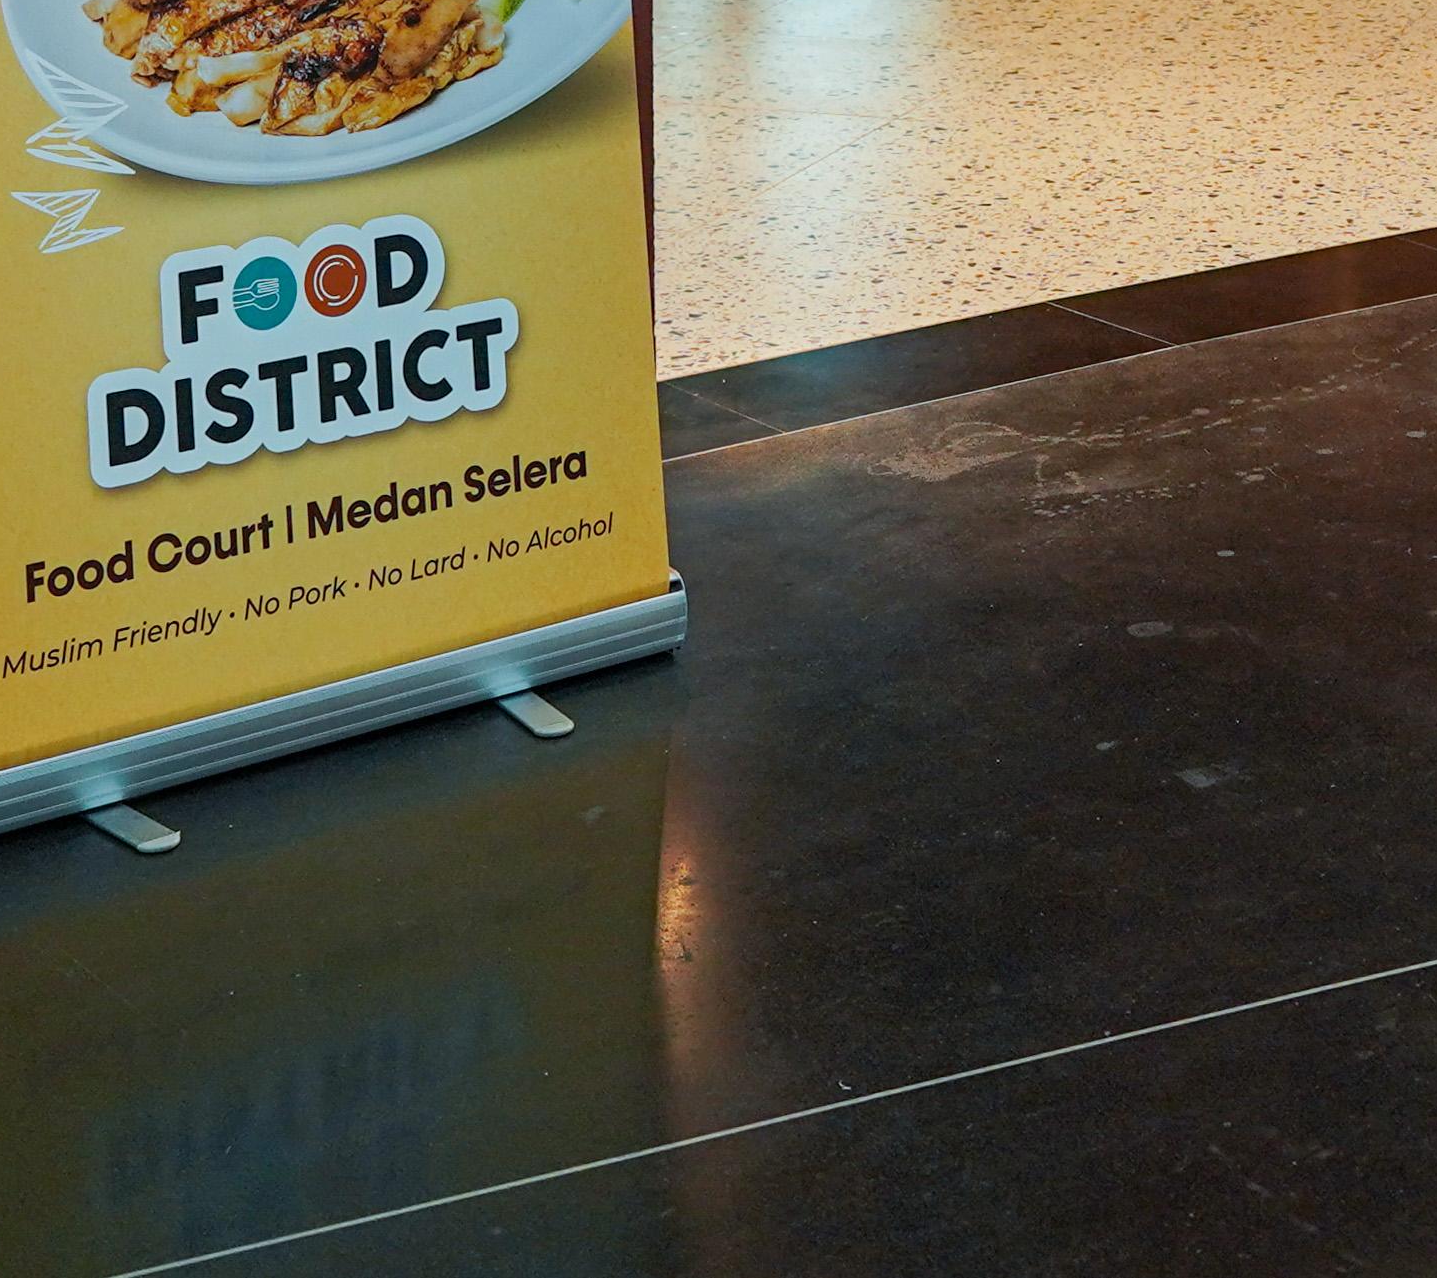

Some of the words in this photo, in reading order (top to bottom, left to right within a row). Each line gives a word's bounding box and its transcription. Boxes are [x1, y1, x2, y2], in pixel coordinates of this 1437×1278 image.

[179, 234, 428, 344] FOOD
[105, 318, 502, 467] DISTRICT
[2, 635, 103, 680] Muslim
[113, 604, 221, 653] Friendly
[244, 592, 281, 620] No
[288, 576, 346, 611] Pork
[368, 565, 403, 590] No
[411, 548, 466, 582] Lard
[486, 537, 520, 563] No
[527, 512, 614, 555] Alcohol
[25, 541, 134, 603] Food
[148, 512, 274, 570] Court
[307, 480, 452, 537] Medan
[464, 448, 588, 503] Selera
